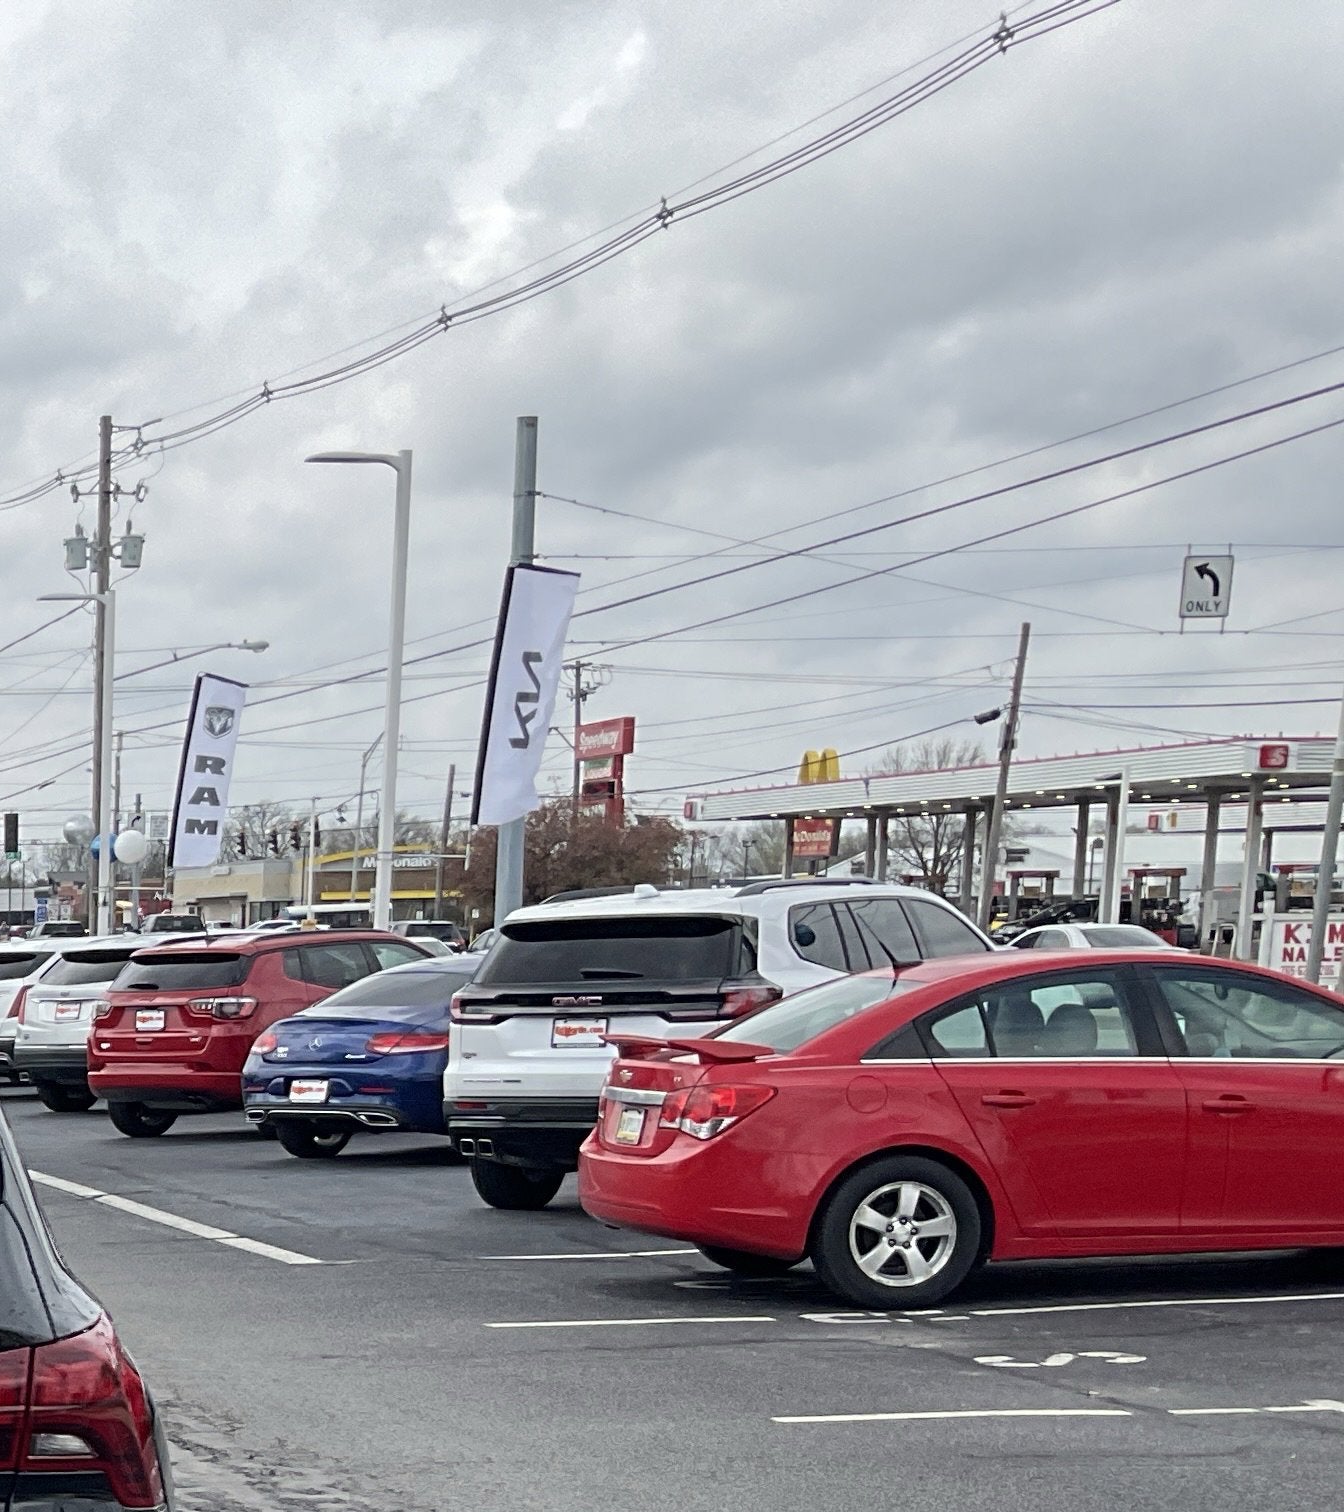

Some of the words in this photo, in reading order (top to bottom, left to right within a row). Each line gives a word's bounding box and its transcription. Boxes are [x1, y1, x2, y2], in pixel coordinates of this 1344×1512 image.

[1186, 600, 1222, 613] ONLY
[579, 729, 620, 752] Speedway
[184, 755, 226, 836] RAM
[552, 996, 602, 1007] GMC
